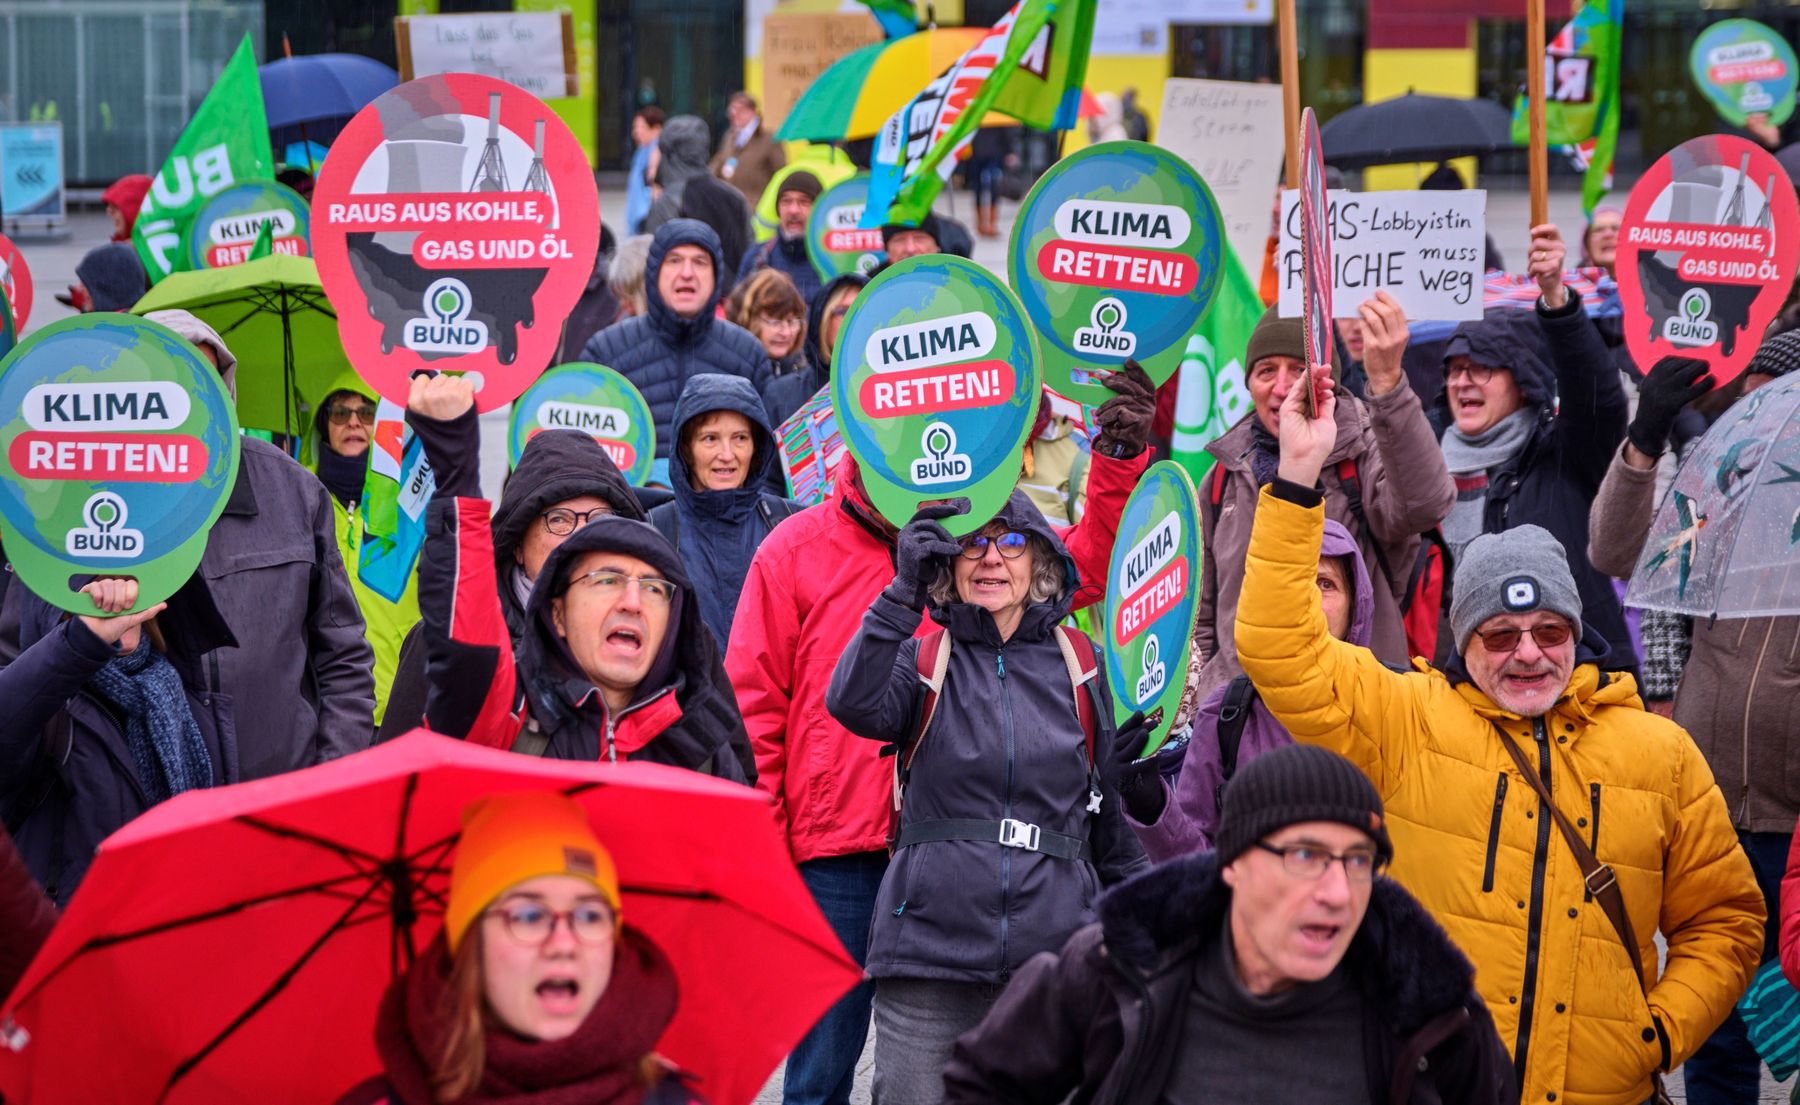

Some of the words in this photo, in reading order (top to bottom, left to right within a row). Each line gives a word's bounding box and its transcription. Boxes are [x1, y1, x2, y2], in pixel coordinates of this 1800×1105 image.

[329, 202, 397, 223] RAUS
[400, 202, 451, 222] AUS
[456, 200, 544, 224] KOHLE,
[1070, 208, 1173, 239] KLIMA
[421, 239, 478, 261] GAS
[479, 239, 536, 260] UND
[539, 233, 573, 259] ÖL
[1629, 226, 1673, 244] RAUS
[1674, 230, 1707, 247] AUS
[1709, 231, 1766, 252] KOHLE,
[1052, 247, 1184, 288] RETTEN!
[1284, 250, 1406, 290] RICHE
[1419, 247, 1477, 261] muss
[1683, 258, 1718, 276] GAS
[1719, 261, 1756, 278] UND
[1759, 260, 1780, 280] ÖL
[1420, 269, 1474, 305] weg
[412, 325, 481, 345] BUND
[880, 322, 981, 365] KLIMA
[1079, 332, 1131, 351] BUND
[1669, 322, 1713, 340] BUND
[874, 368, 1001, 410] RETTEN!
[43, 392, 170, 422] KLIMA
[549, 407, 617, 432] KLIMA
[28, 440, 189, 473] RETTEN!
[916, 460, 966, 479] BUND
[74, 534, 137, 551] BUND
[1126, 524, 1174, 589] KLIMA
[1121, 565, 1182, 637] RETTEN!
[1139, 665, 1163, 698] BUND
